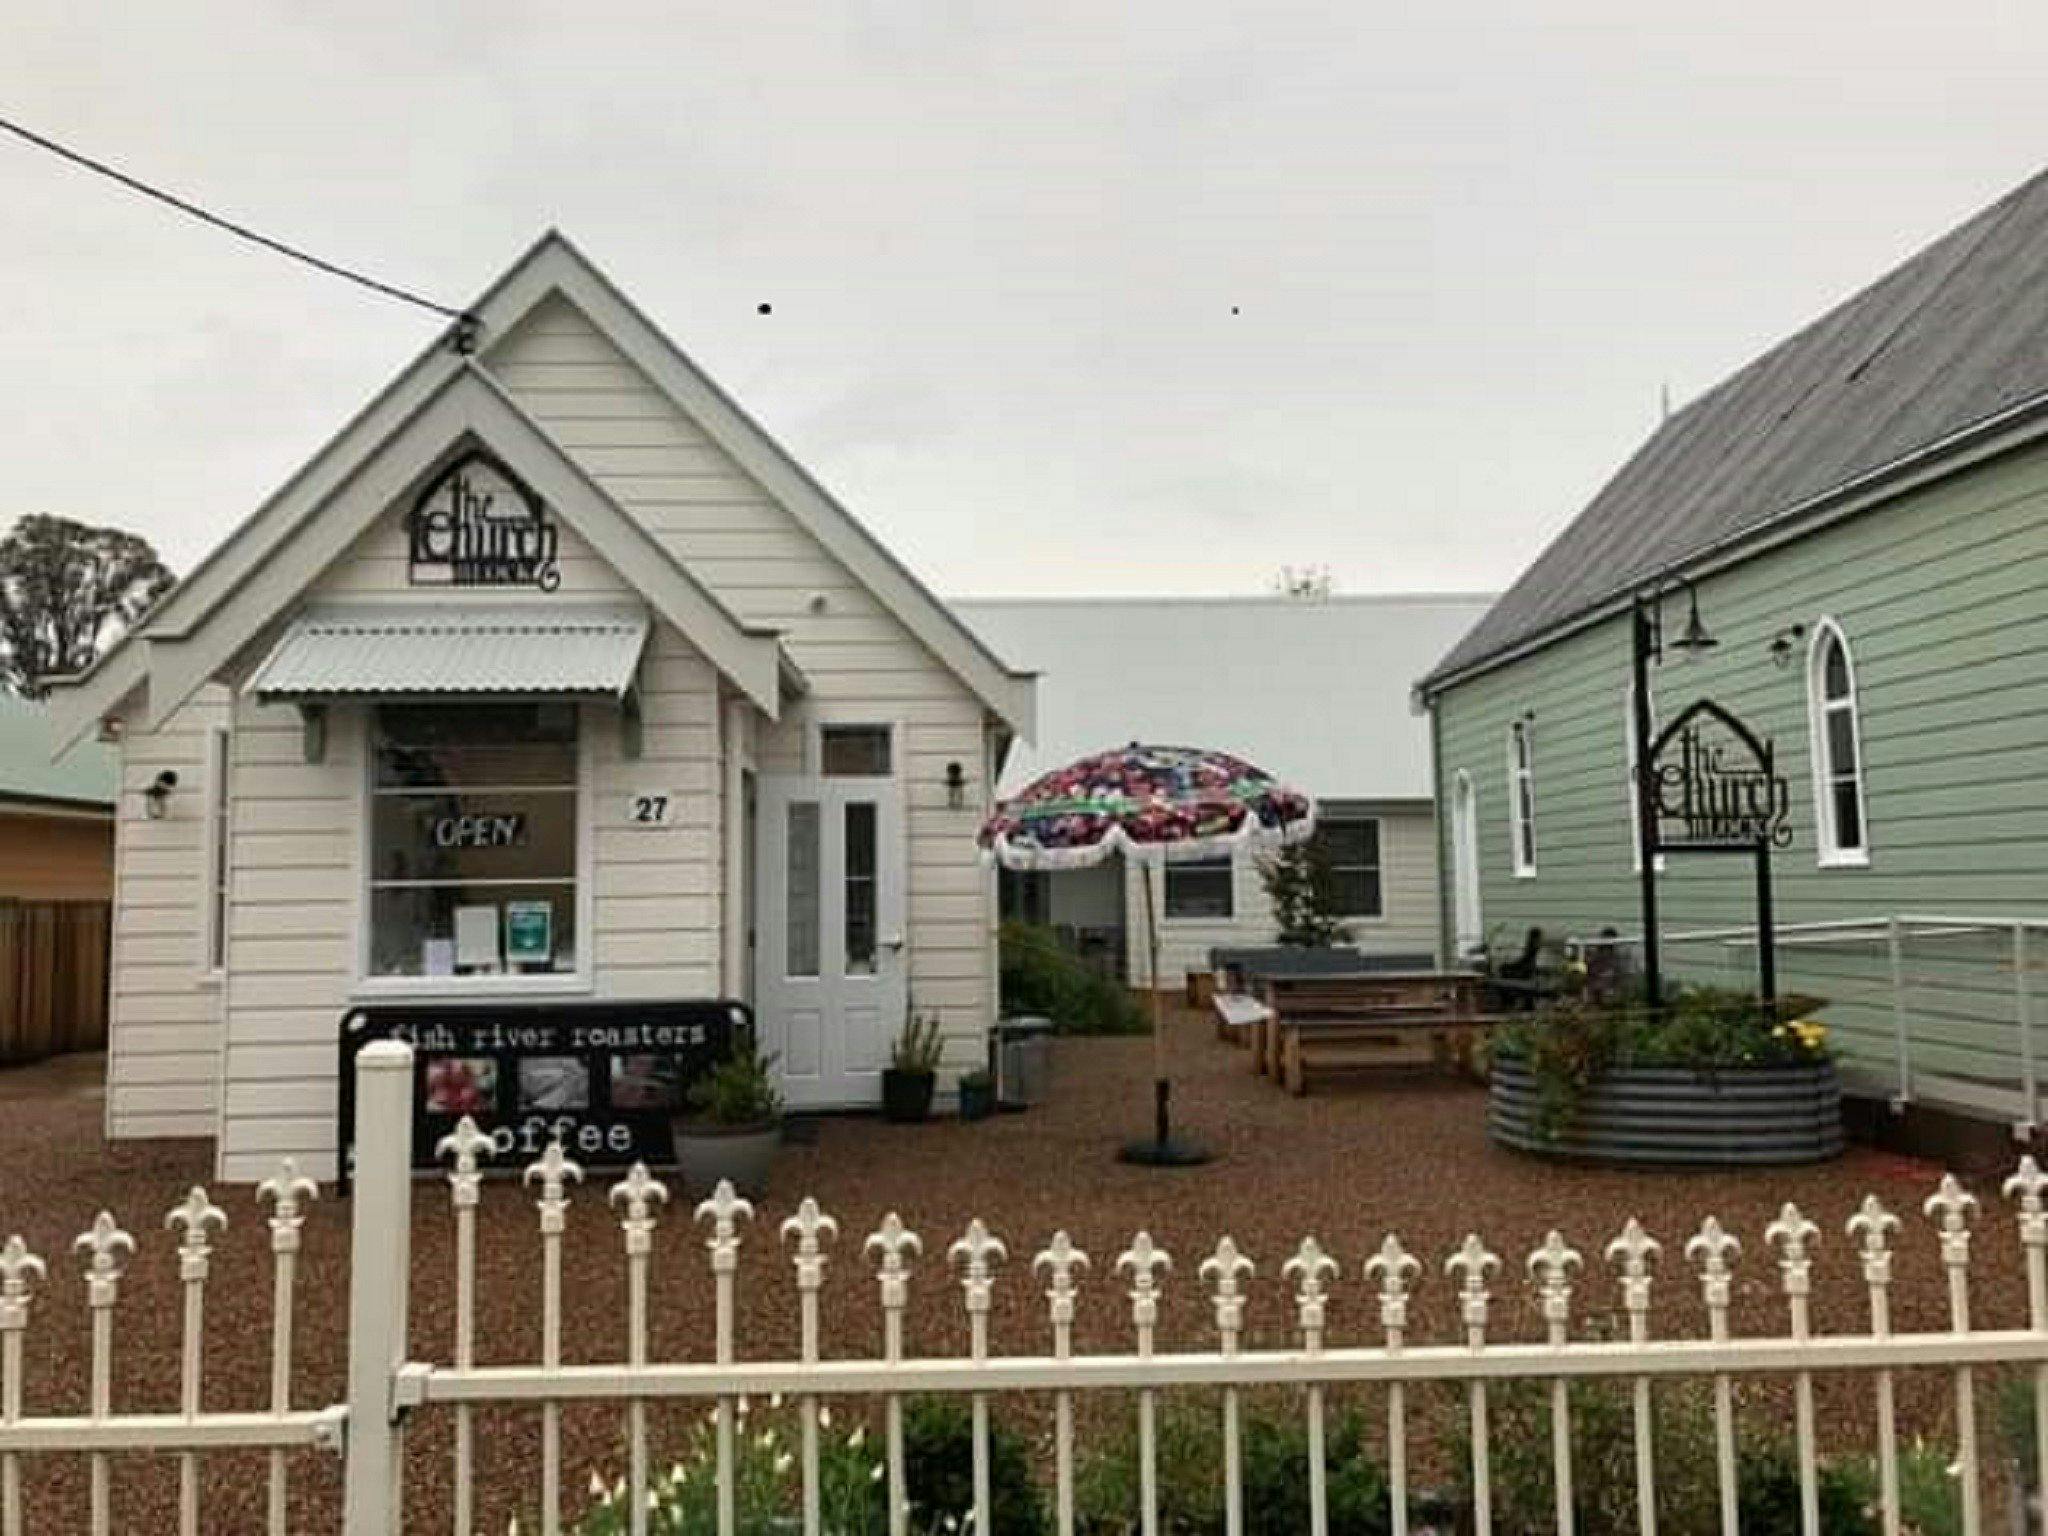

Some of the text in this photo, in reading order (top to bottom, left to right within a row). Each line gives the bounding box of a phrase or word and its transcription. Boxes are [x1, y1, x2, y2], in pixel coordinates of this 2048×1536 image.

[636, 797, 668, 821] 27
[436, 817, 518, 846] OPEN
[474, 1022, 556, 1047] river
[571, 1022, 706, 1046] roasters
[487, 1116, 631, 1153] offee
